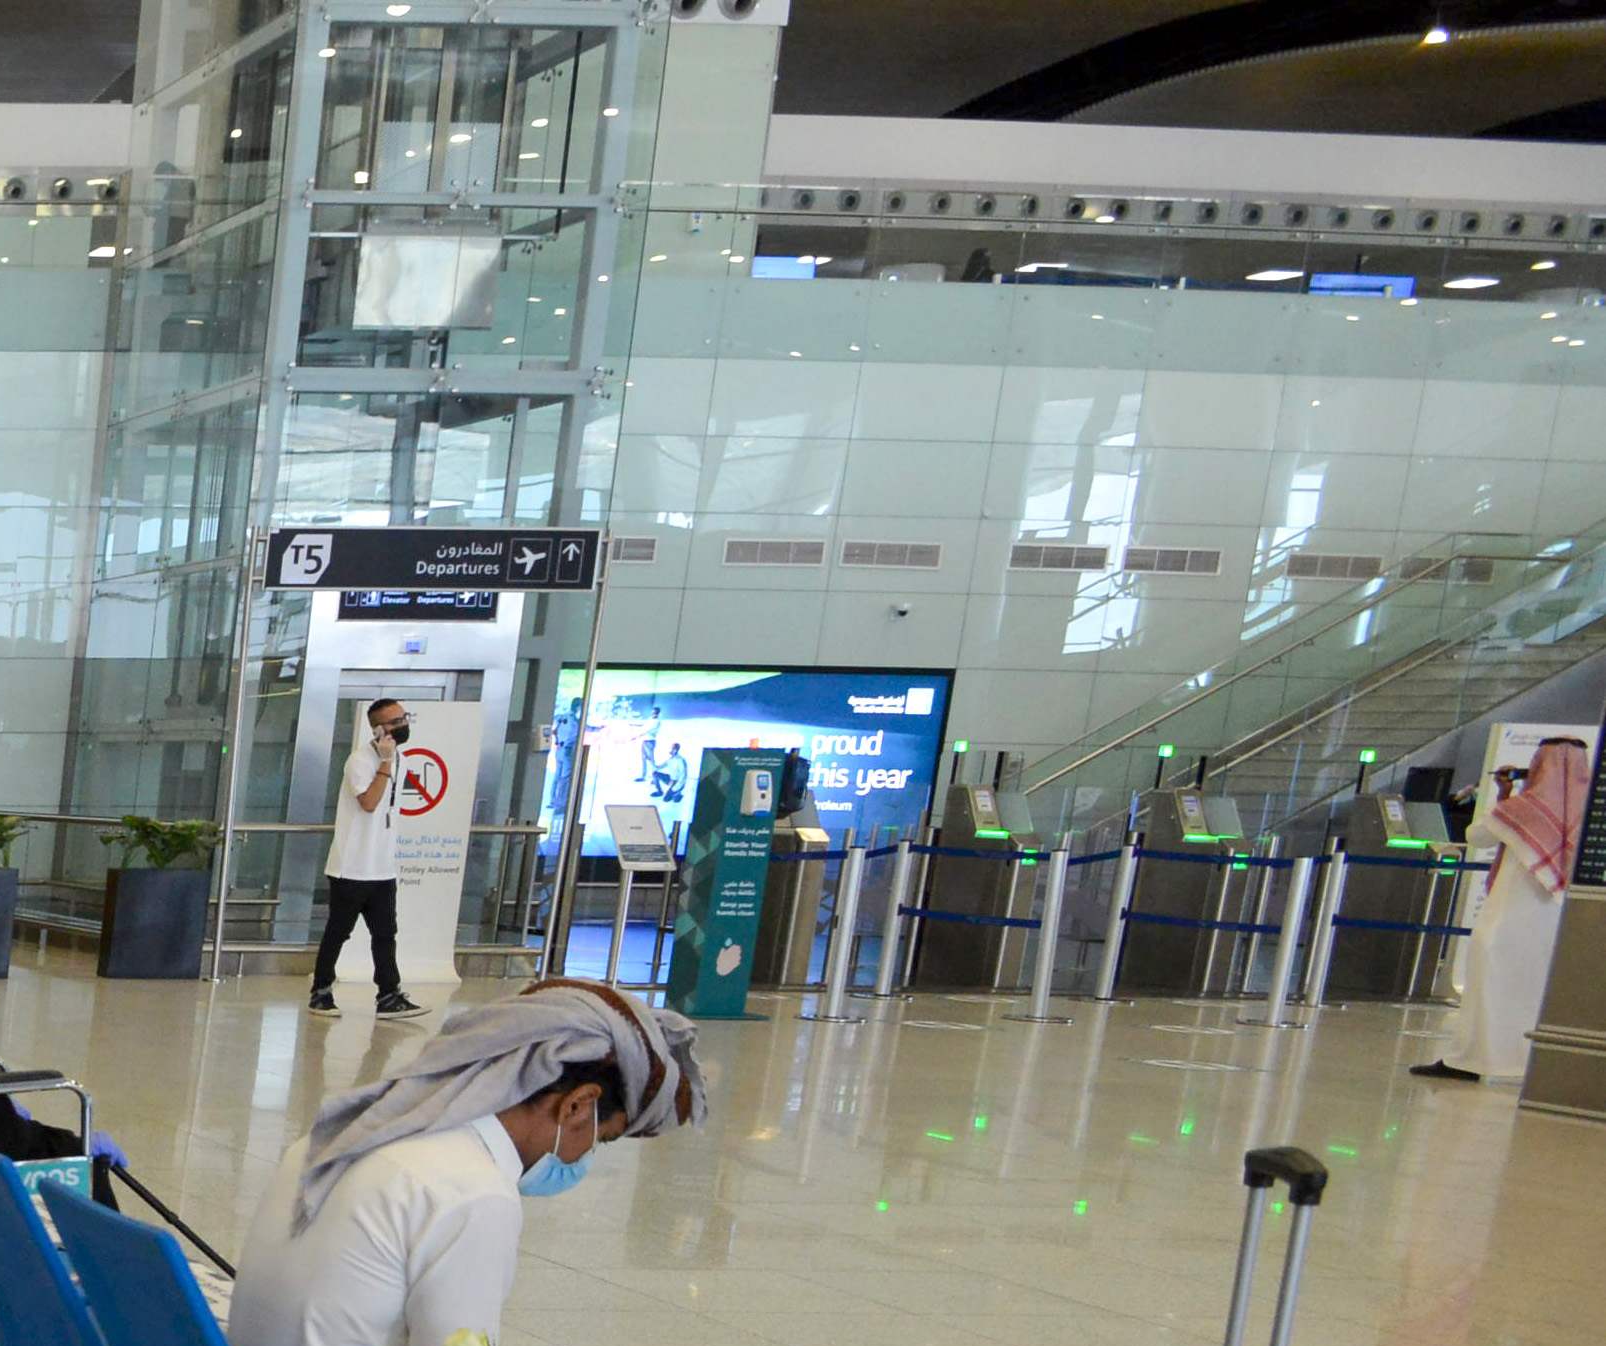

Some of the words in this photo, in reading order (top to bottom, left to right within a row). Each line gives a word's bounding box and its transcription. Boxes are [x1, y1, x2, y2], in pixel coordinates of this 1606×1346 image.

[436, 541, 503, 559] المغادرون
[290, 544, 324, 575] T5
[415, 560, 500, 578] Departures
[417, 596, 454, 605] Departures
[810, 729, 884, 763] proud
[855, 767, 914, 796] year
[723, 849, 748, 857] Hands
[748, 849, 766, 857] Here
[400, 865, 426, 876] Trolley
[427, 865, 460, 874] Allowed
